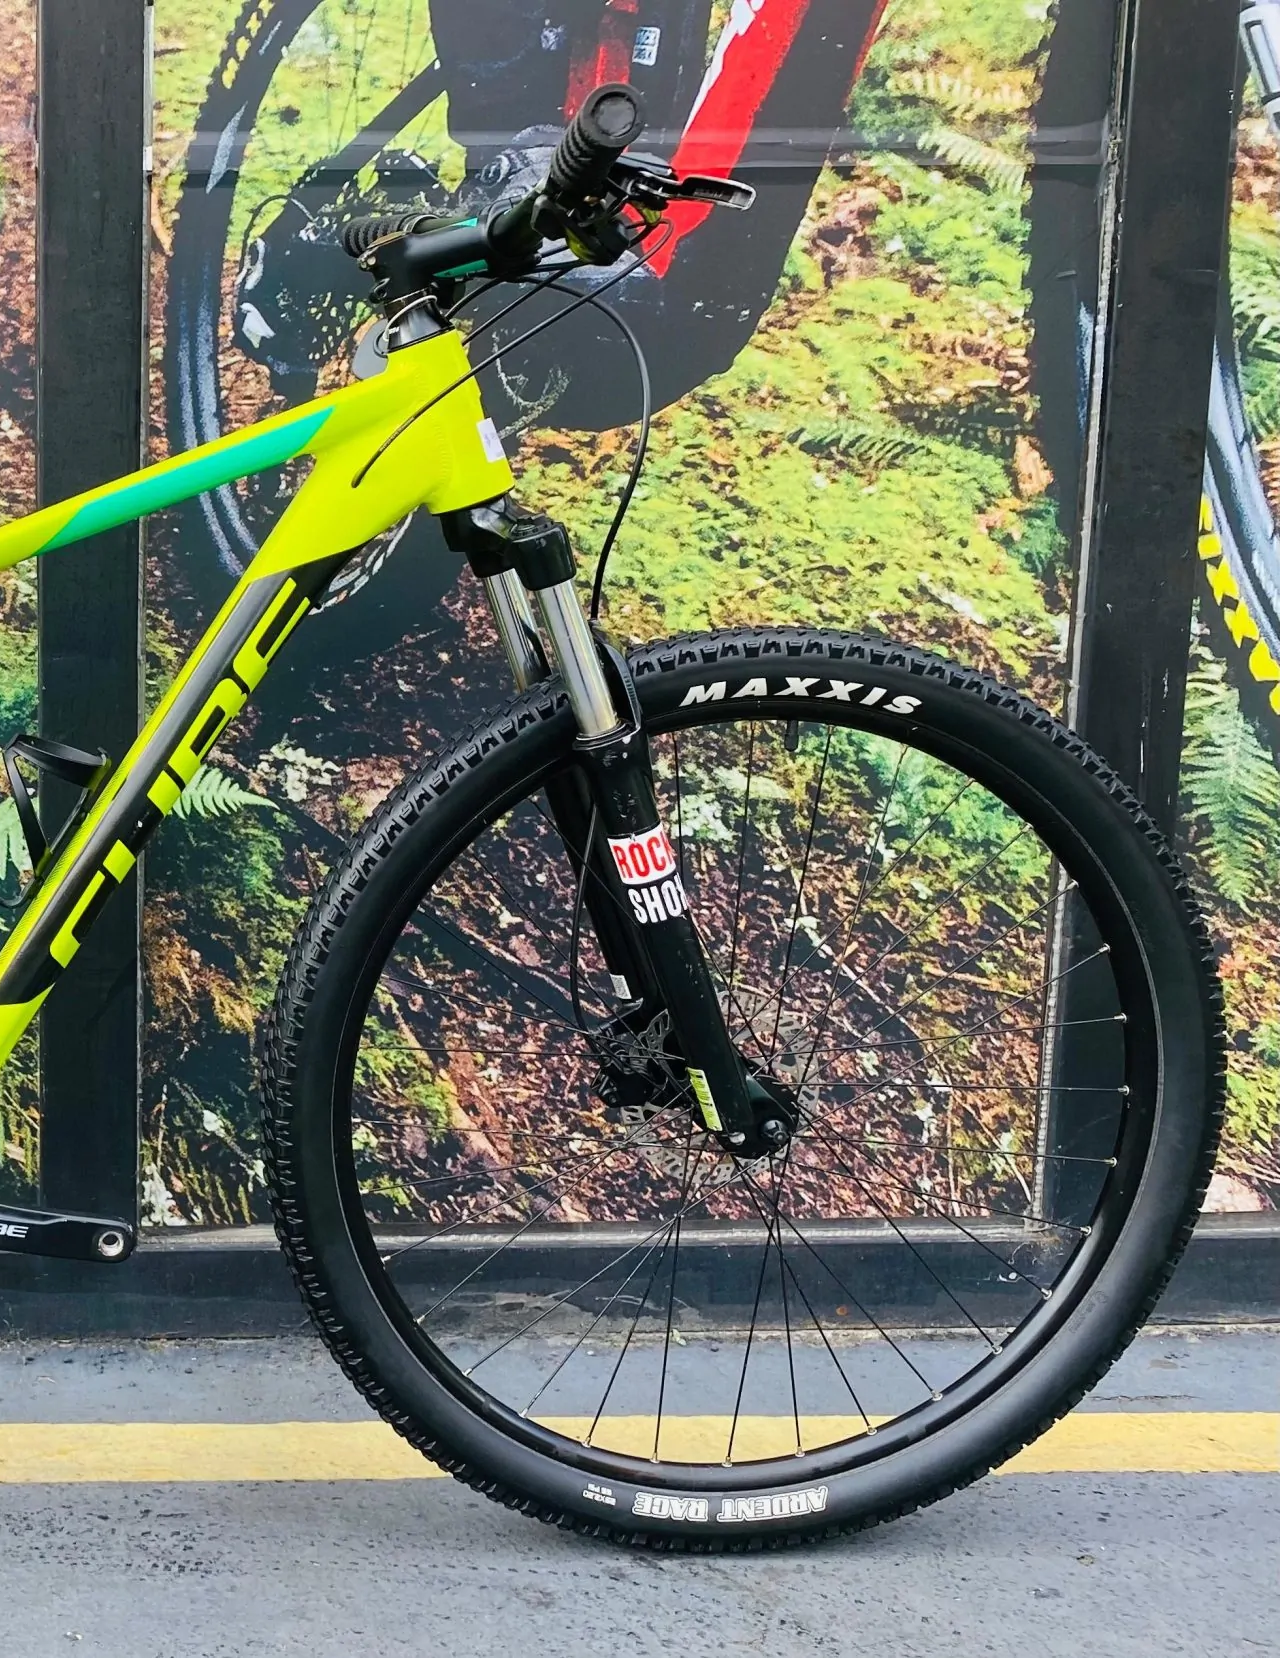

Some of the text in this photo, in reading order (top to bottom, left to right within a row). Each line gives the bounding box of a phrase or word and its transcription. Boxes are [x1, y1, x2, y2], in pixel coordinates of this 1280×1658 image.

[679, 677, 922, 714] MAXXIS
[632, 1486, 829, 1522] ARDENT RACE
